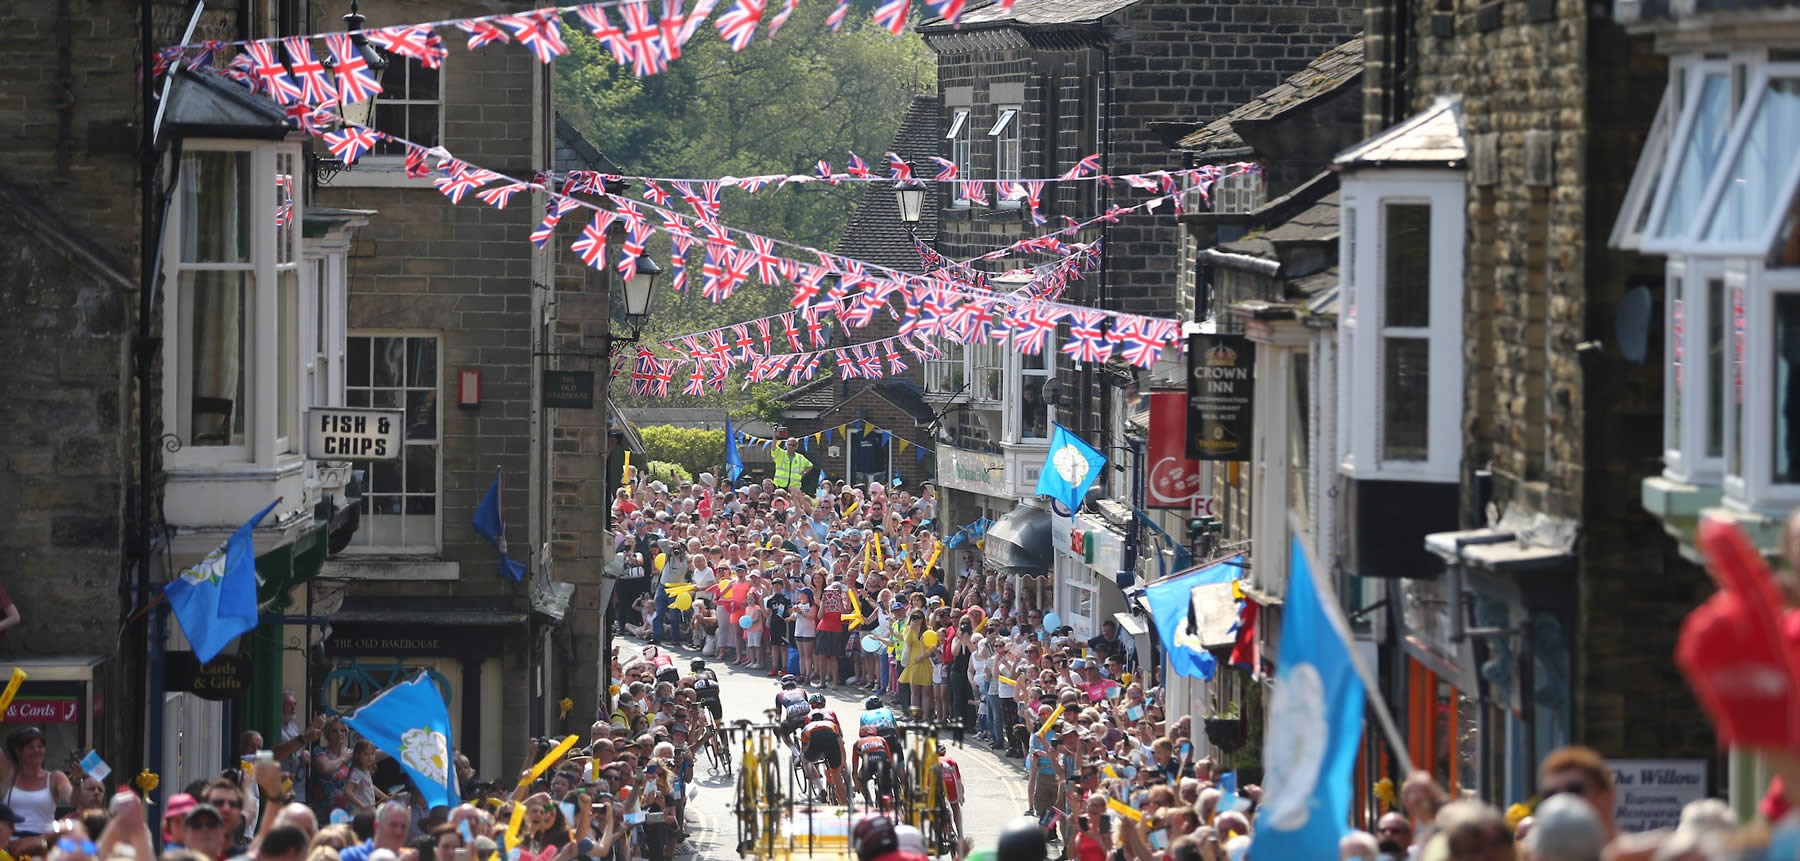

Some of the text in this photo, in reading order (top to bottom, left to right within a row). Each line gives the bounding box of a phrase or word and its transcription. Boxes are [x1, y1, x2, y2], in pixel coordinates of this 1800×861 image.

[1194, 367, 1247, 379] CROWN
[1207, 381, 1234, 393] INN
[321, 415, 391, 434] FISH &
[324, 437, 386, 456] CHIPS
[336, 640, 439, 648] THE OLD BAKEHOUSE
[7, 704, 56, 716] & Cards
[1641, 768, 1700, 784] Willow
